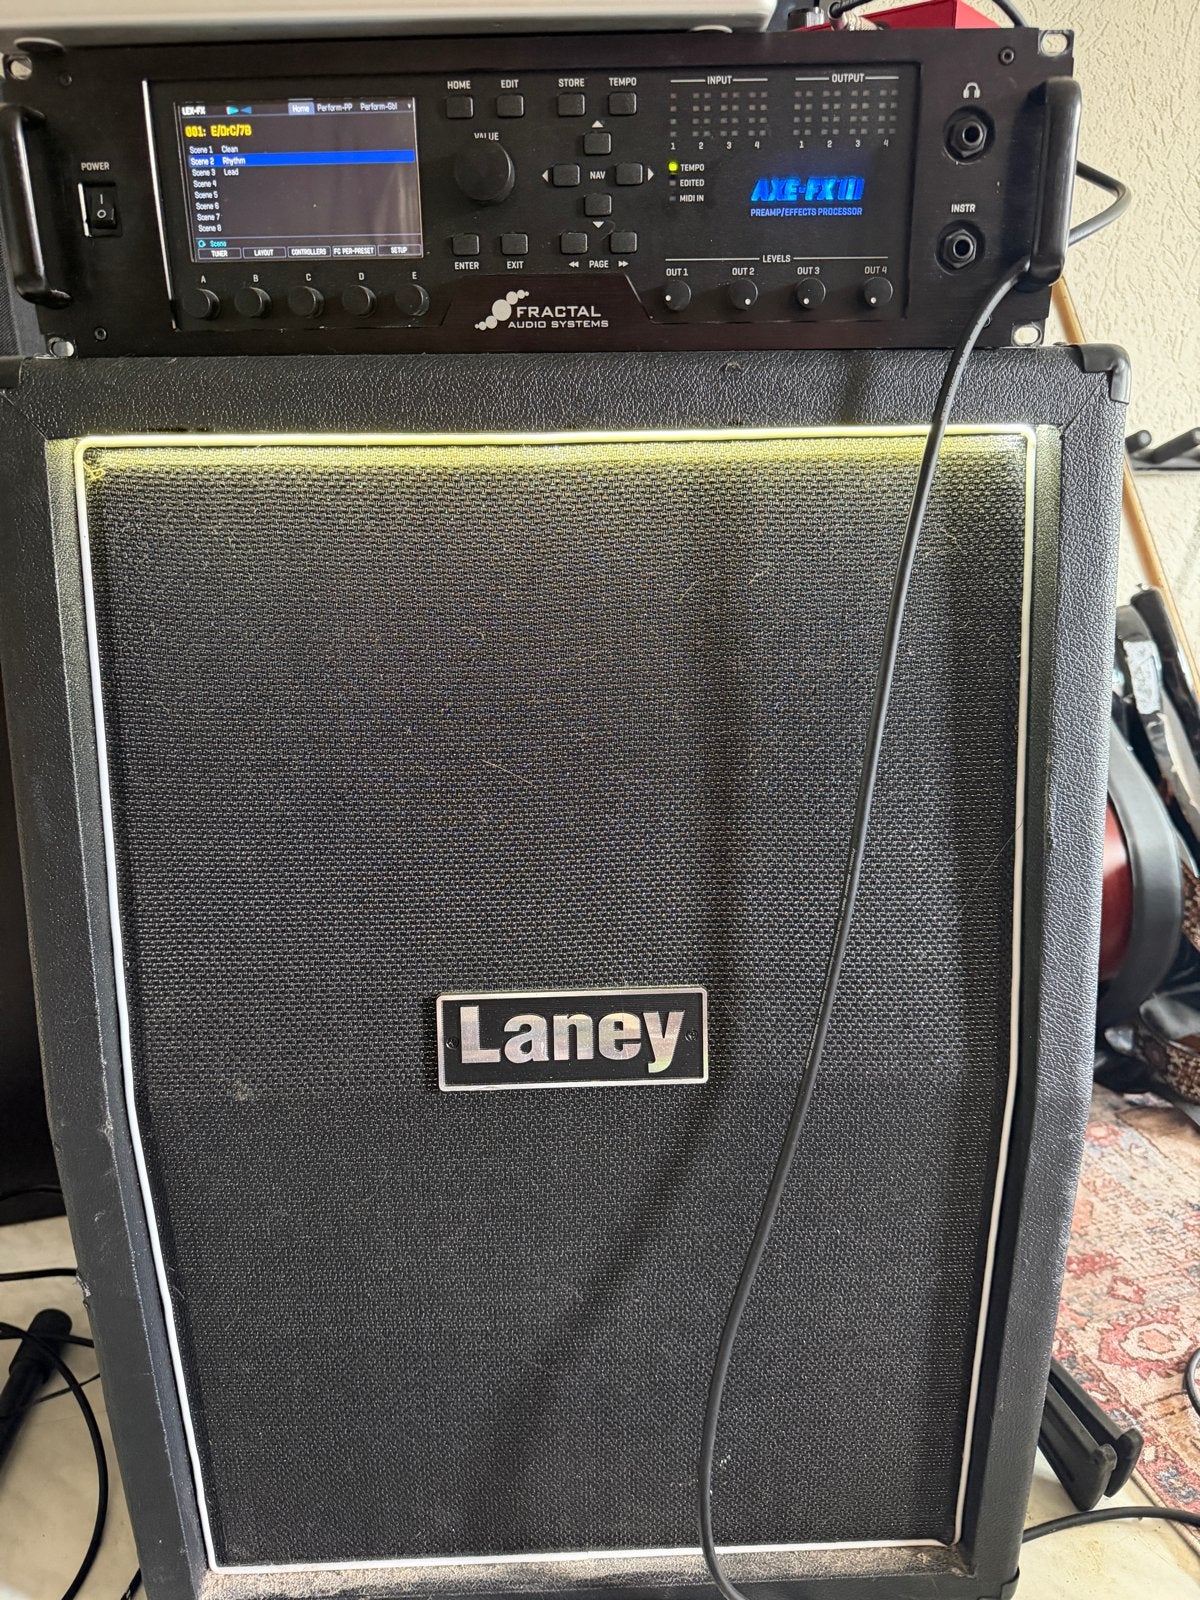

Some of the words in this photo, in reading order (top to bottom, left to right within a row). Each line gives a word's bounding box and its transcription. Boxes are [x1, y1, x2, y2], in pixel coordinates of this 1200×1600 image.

[558, 78, 584, 88] STORE
[609, 77, 636, 86] TEMPO
[707, 76, 732, 84] INPUT
[832, 74, 864, 83] OUTPUT
[447, 80, 471, 90] HOME
[500, 80, 518, 88] EDIT
[292, 104, 310, 112] Home
[317, 103, 352, 112] Perform-PP
[185, 126, 206, 137] 001:
[190, 146, 208, 154] Scene
[209, 146, 213, 154] 1
[222, 145, 238, 153] Clean
[698, 142, 704, 150] 2
[726, 142, 732, 150] 3
[754, 141, 760, 149] 4
[800, 141, 804, 149] 1
[190, 158, 209, 166] Scene
[210, 157, 214, 165] 2
[222, 156, 246, 166] Rhythm
[81, 162, 110, 171] POWER
[224, 168, 239, 176] Lead
[590, 171, 606, 180] NAV
[751, 177, 836, 202] AXE-FX
[194, 191, 212, 199] Scene
[196, 202, 214, 210] Scene
[952, 204, 976, 213] INSTR
[750, 208, 816, 217] PREAMP/EFFECTS
[818, 207, 862, 216] PROCESSOR
[291, 248, 326, 256] CONTROLLERS
[342, 247, 374, 255] PER-PRESET
[762, 254, 791, 263] LEVELS
[454, 262, 479, 270] ENTER
[507, 261, 524, 269] EXIT
[589, 260, 608, 269] PAGE
[666, 268, 681, 277] OUT
[683, 268, 688, 276] 1
[732, 267, 747, 276] OUT
[748, 267, 754, 276] 2
[797, 267, 812, 275] OUT
[814, 267, 820, 275] 3
[864, 266, 880, 275] OUT
[881, 266, 888, 274] 4
[201, 275, 206, 284] A
[254, 274, 259, 282] B
[306, 273, 312, 282] C
[358, 272, 364, 281] D
[412, 272, 418, 280] E
[516, 306, 602, 318] FRACTAL
[508, 320, 546, 329] AUDIO
[551, 320, 609, 328] SYSTEMS
[459, 1005, 685, 1074] Laney
